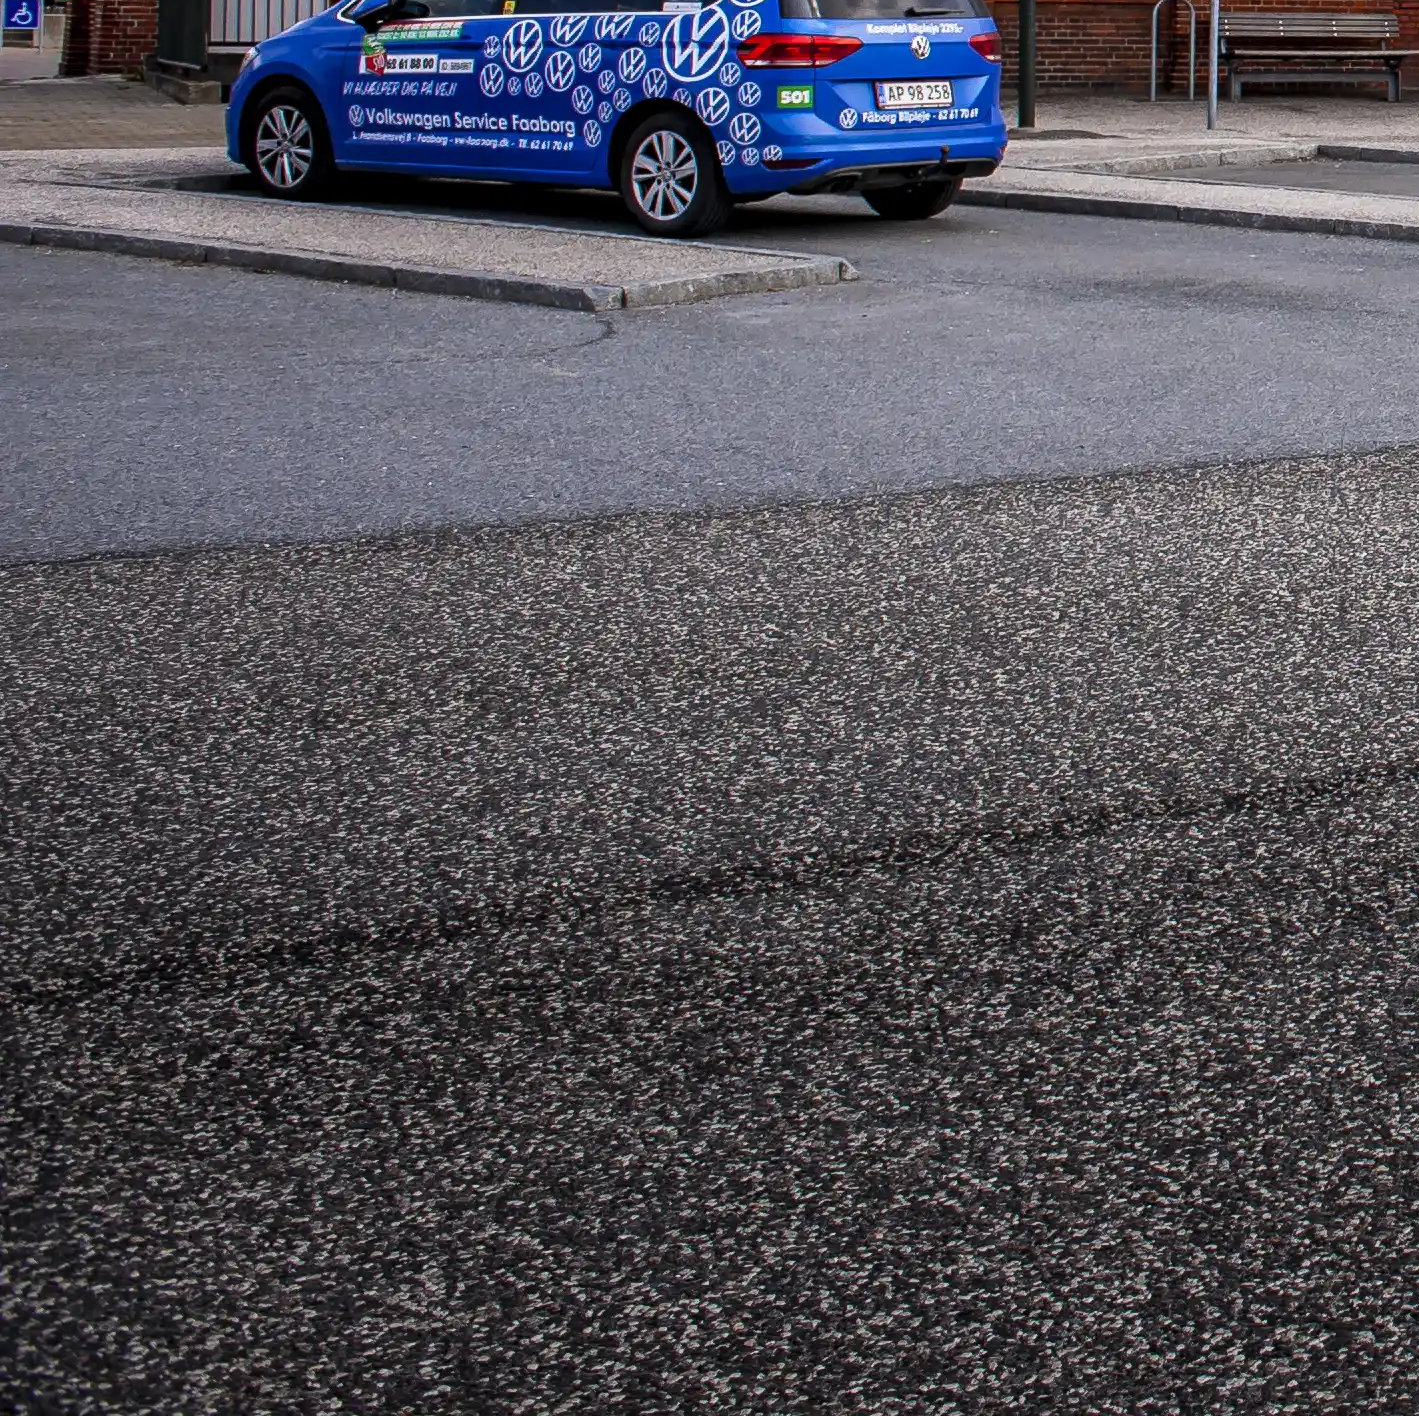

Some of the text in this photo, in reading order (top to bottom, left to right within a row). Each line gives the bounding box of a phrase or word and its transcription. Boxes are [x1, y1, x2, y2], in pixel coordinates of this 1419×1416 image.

[889, 86, 904, 101] AP
[908, 85, 924, 100] 98
[926, 84, 950, 100] 258
[365, 107, 576, 138] Volkswagen Service Faaborg
[552, 141, 562, 150] 70
